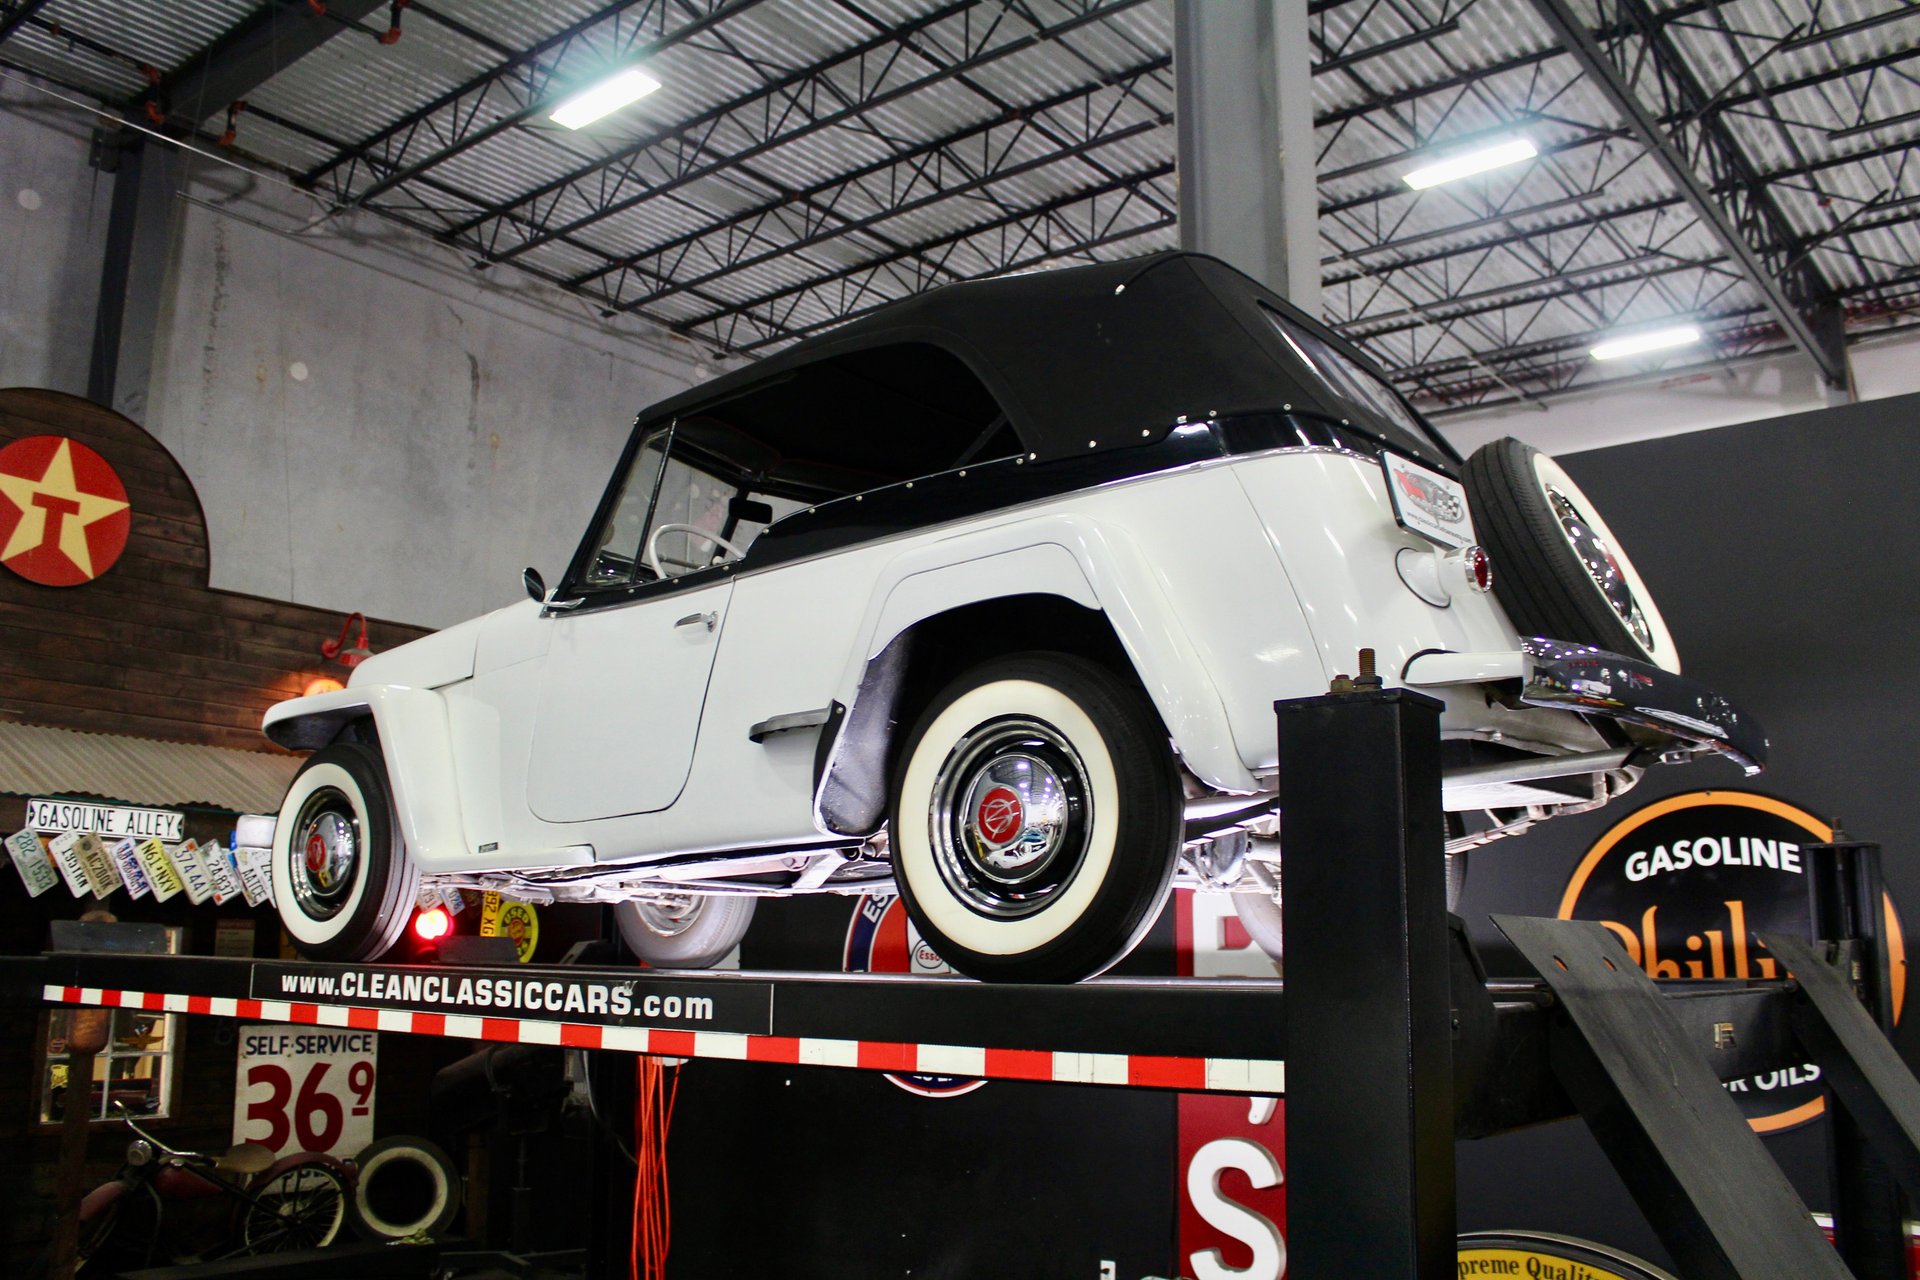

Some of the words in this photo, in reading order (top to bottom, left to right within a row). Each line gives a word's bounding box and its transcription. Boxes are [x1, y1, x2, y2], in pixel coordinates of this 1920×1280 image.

[31, 491, 81, 548] T
[38, 803, 115, 832] GASOLINE
[126, 811, 175, 836] ALLEY
[1624, 836, 1803, 882] GASOLINE
[280, 971, 714, 1020] www.CLEANCLASSICCARS.com
[1754, 1063, 1821, 1091] OILS
[1458, 1258, 1520, 1280] preme
[1526, 1256, 1602, 1280] Qualit
